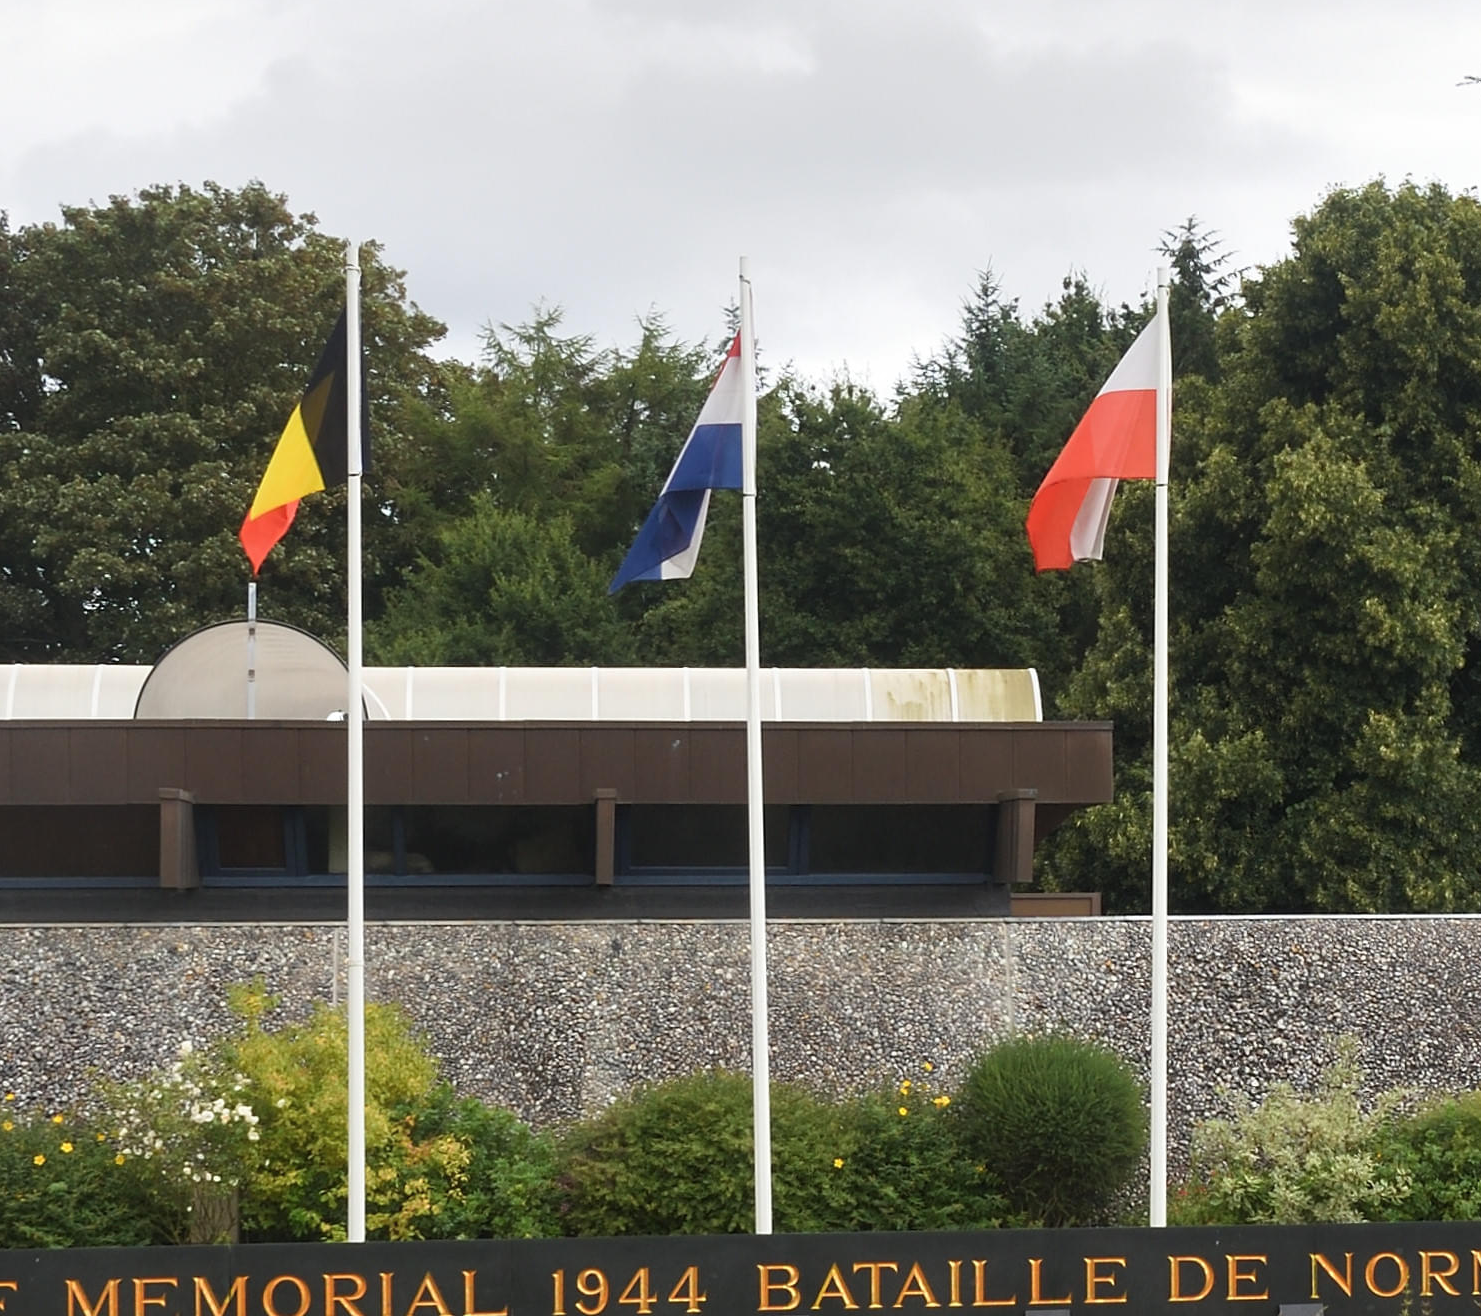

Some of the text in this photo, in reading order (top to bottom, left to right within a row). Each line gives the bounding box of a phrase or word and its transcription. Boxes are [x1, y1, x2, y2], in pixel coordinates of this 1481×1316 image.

[553, 1265, 707, 1316] 1944
[758, 1256, 1128, 1312] BATAILLE
[1170, 1254, 1269, 1302] DE
